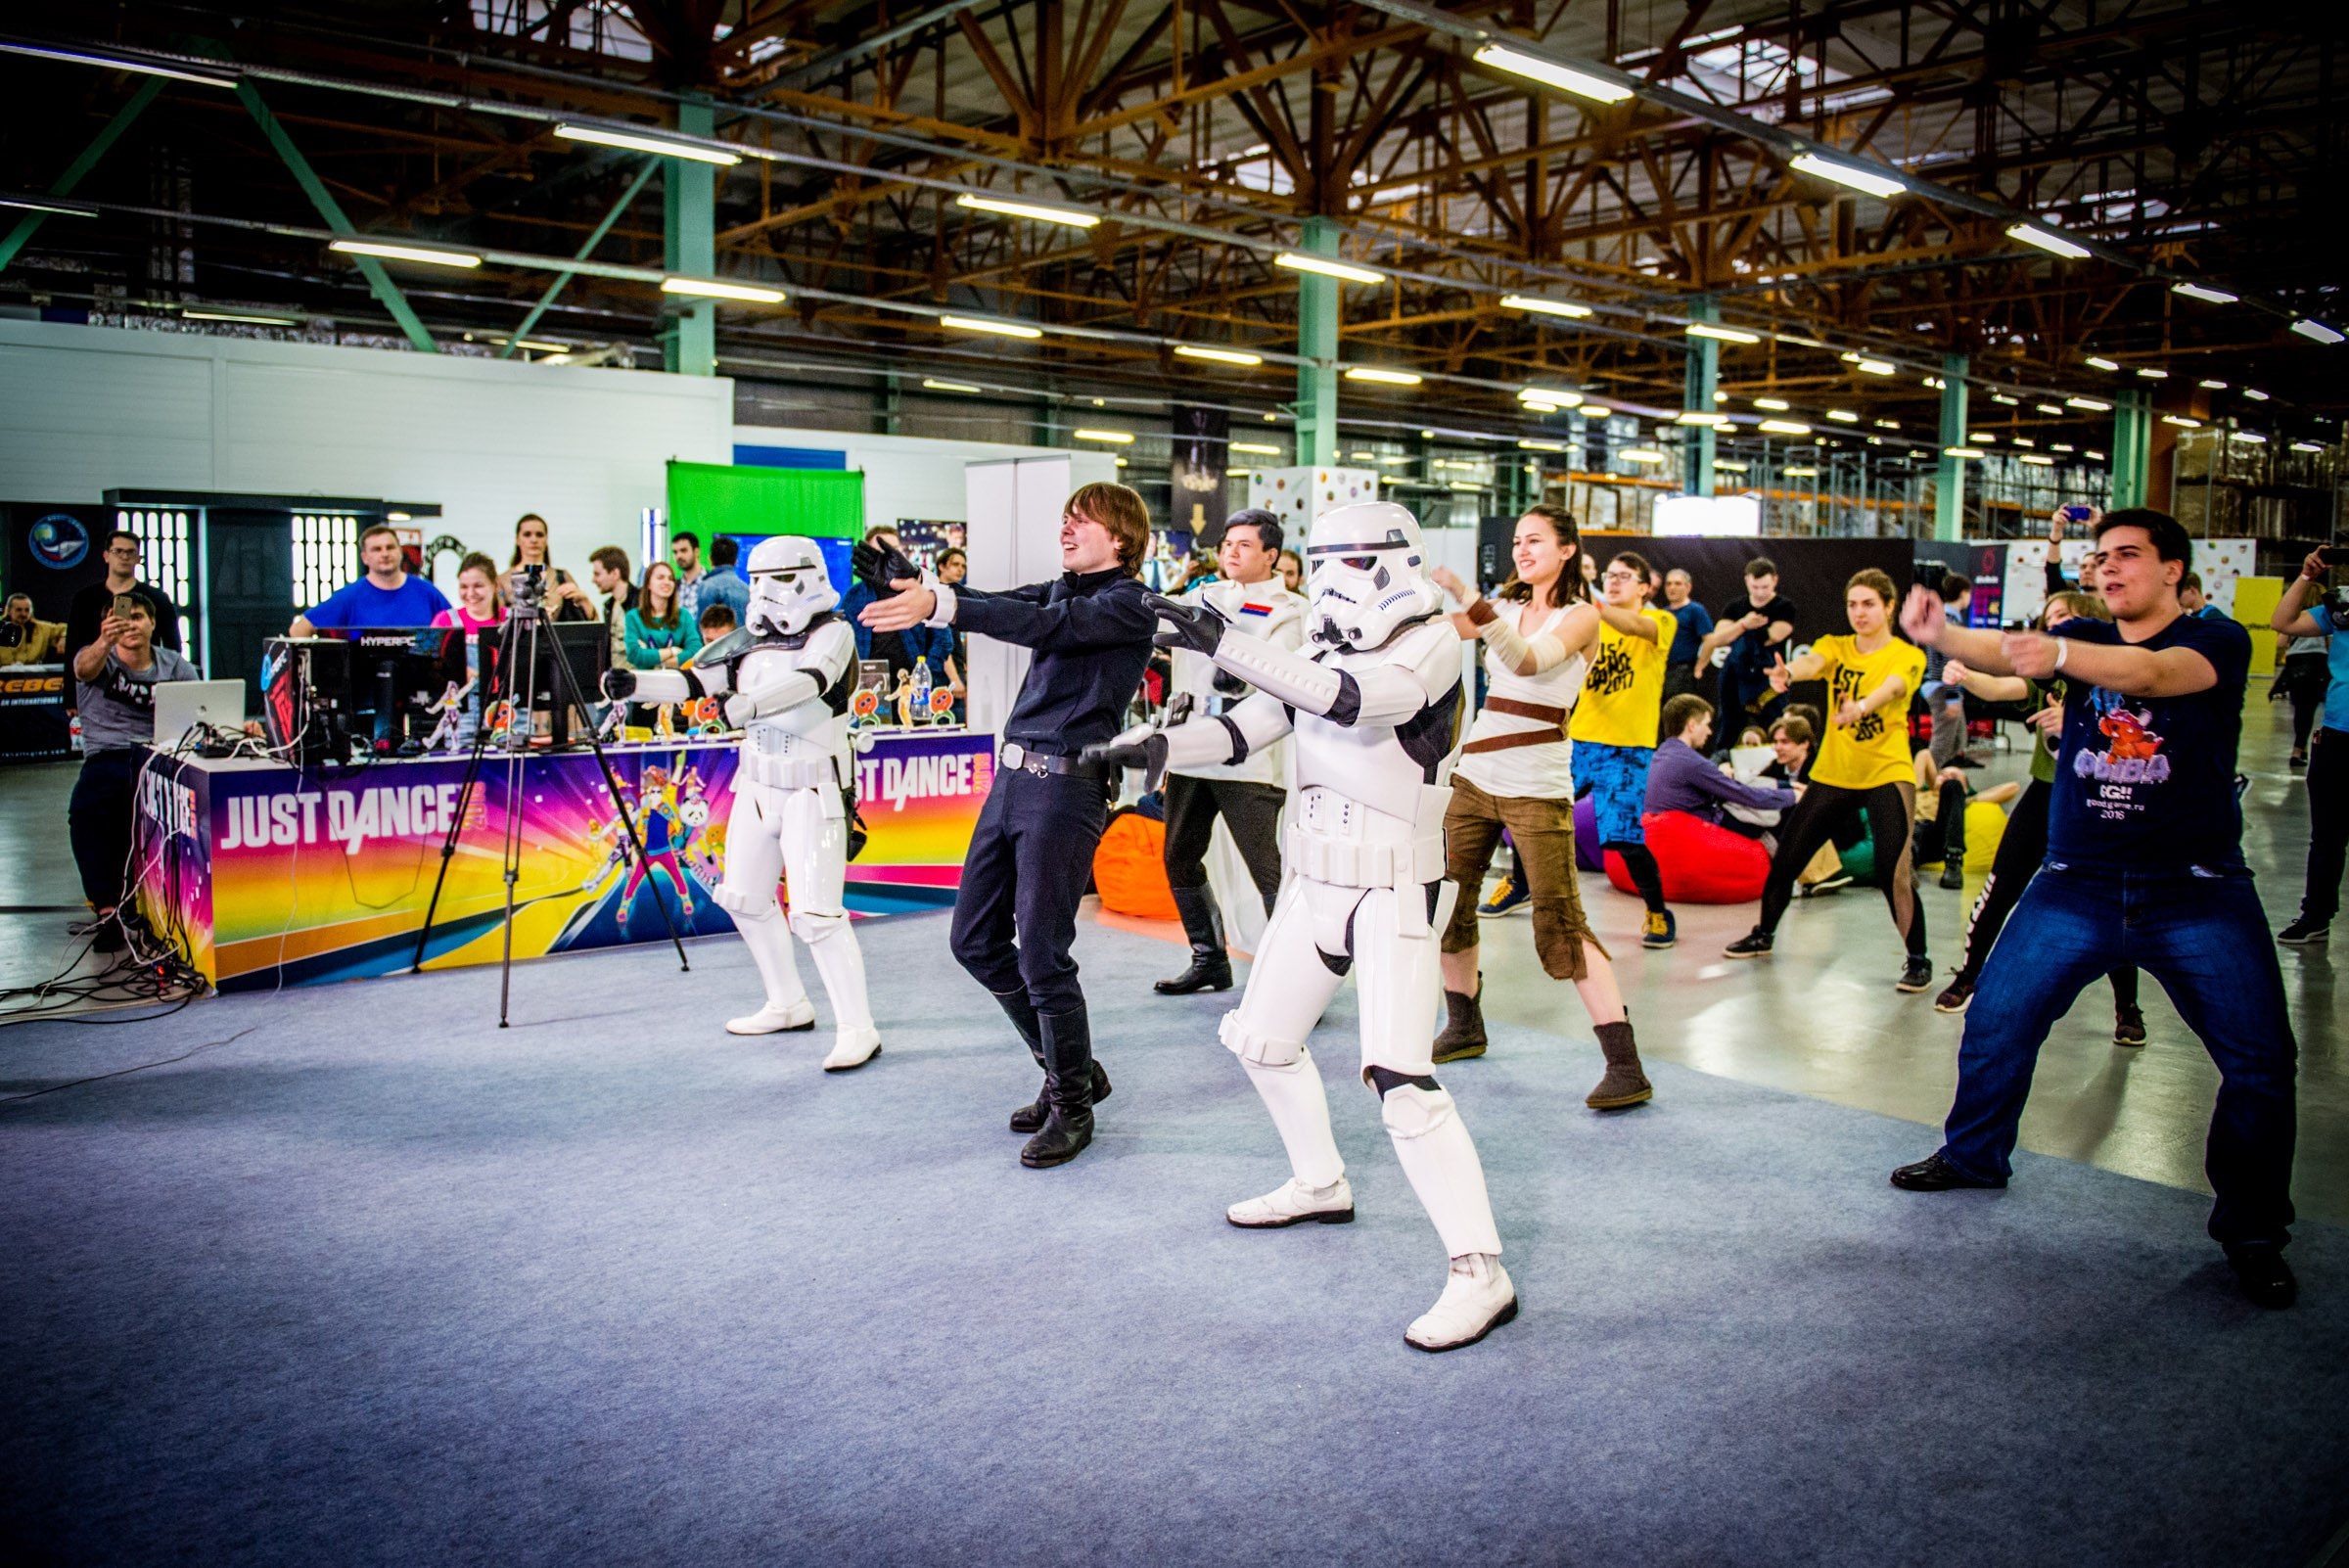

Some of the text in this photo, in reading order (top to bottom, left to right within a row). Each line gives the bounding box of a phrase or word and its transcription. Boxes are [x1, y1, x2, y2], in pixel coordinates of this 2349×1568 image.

[360, 636, 416, 646] HYPERPC
[0, 677, 64, 693] EBE
[1603, 670, 1635, 696] 2017
[883, 754, 971, 811] DANCE
[220, 792, 321, 850] JUST
[328, 783, 458, 854] DANCE
